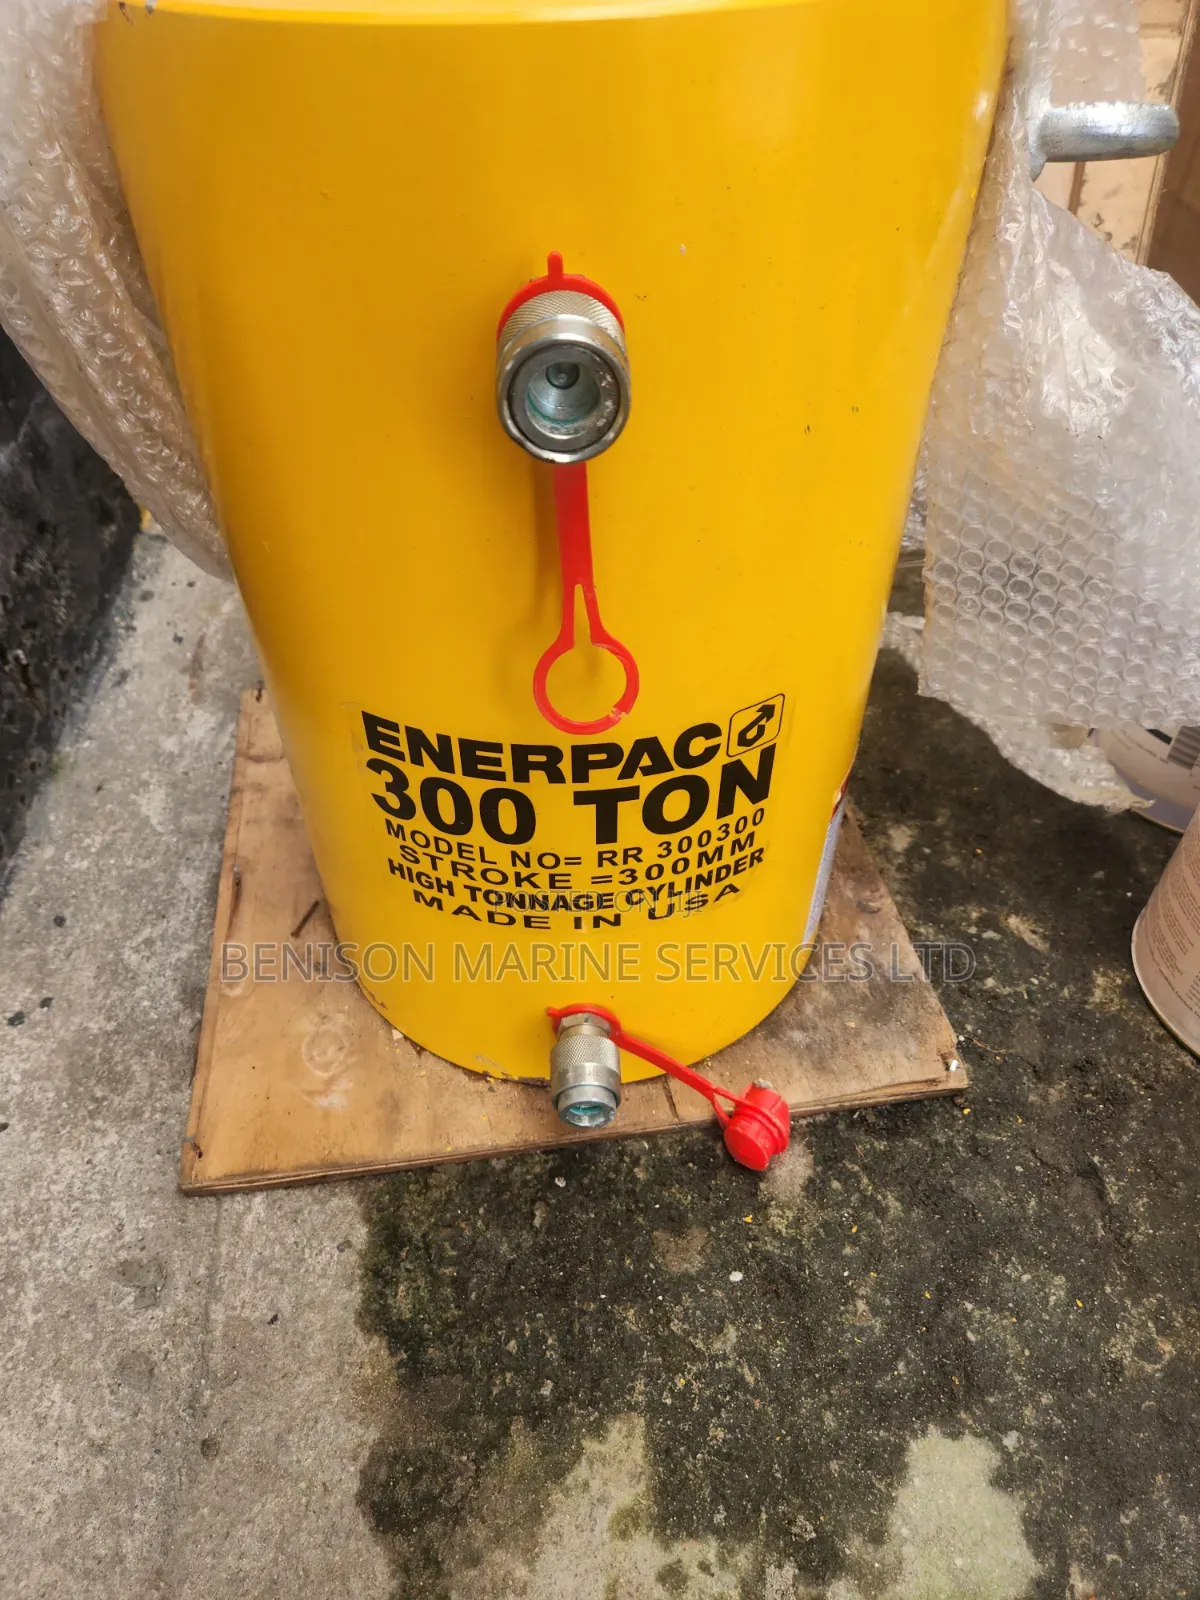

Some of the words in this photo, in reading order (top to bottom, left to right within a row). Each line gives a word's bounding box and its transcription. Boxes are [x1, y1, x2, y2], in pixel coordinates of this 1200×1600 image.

[361, 710, 722, 784] ENERPAC
[366, 757, 537, 845] 300
[573, 743, 778, 845] TON
[385, 818, 497, 865] MODEL
[510, 850, 582, 869] NO=
[597, 846, 644, 868] RR
[656, 807, 765, 859] 300300
[399, 844, 573, 890] STROKE
[590, 831, 756, 886] =300MM
[387, 858, 455, 897] HIGH
[463, 884, 614, 912] TONNAGE
[625, 848, 765, 906] CYLINDER
[413, 889, 551, 930] MADE
[574, 914, 622, 930] IN
[648, 883, 740, 920] USA
